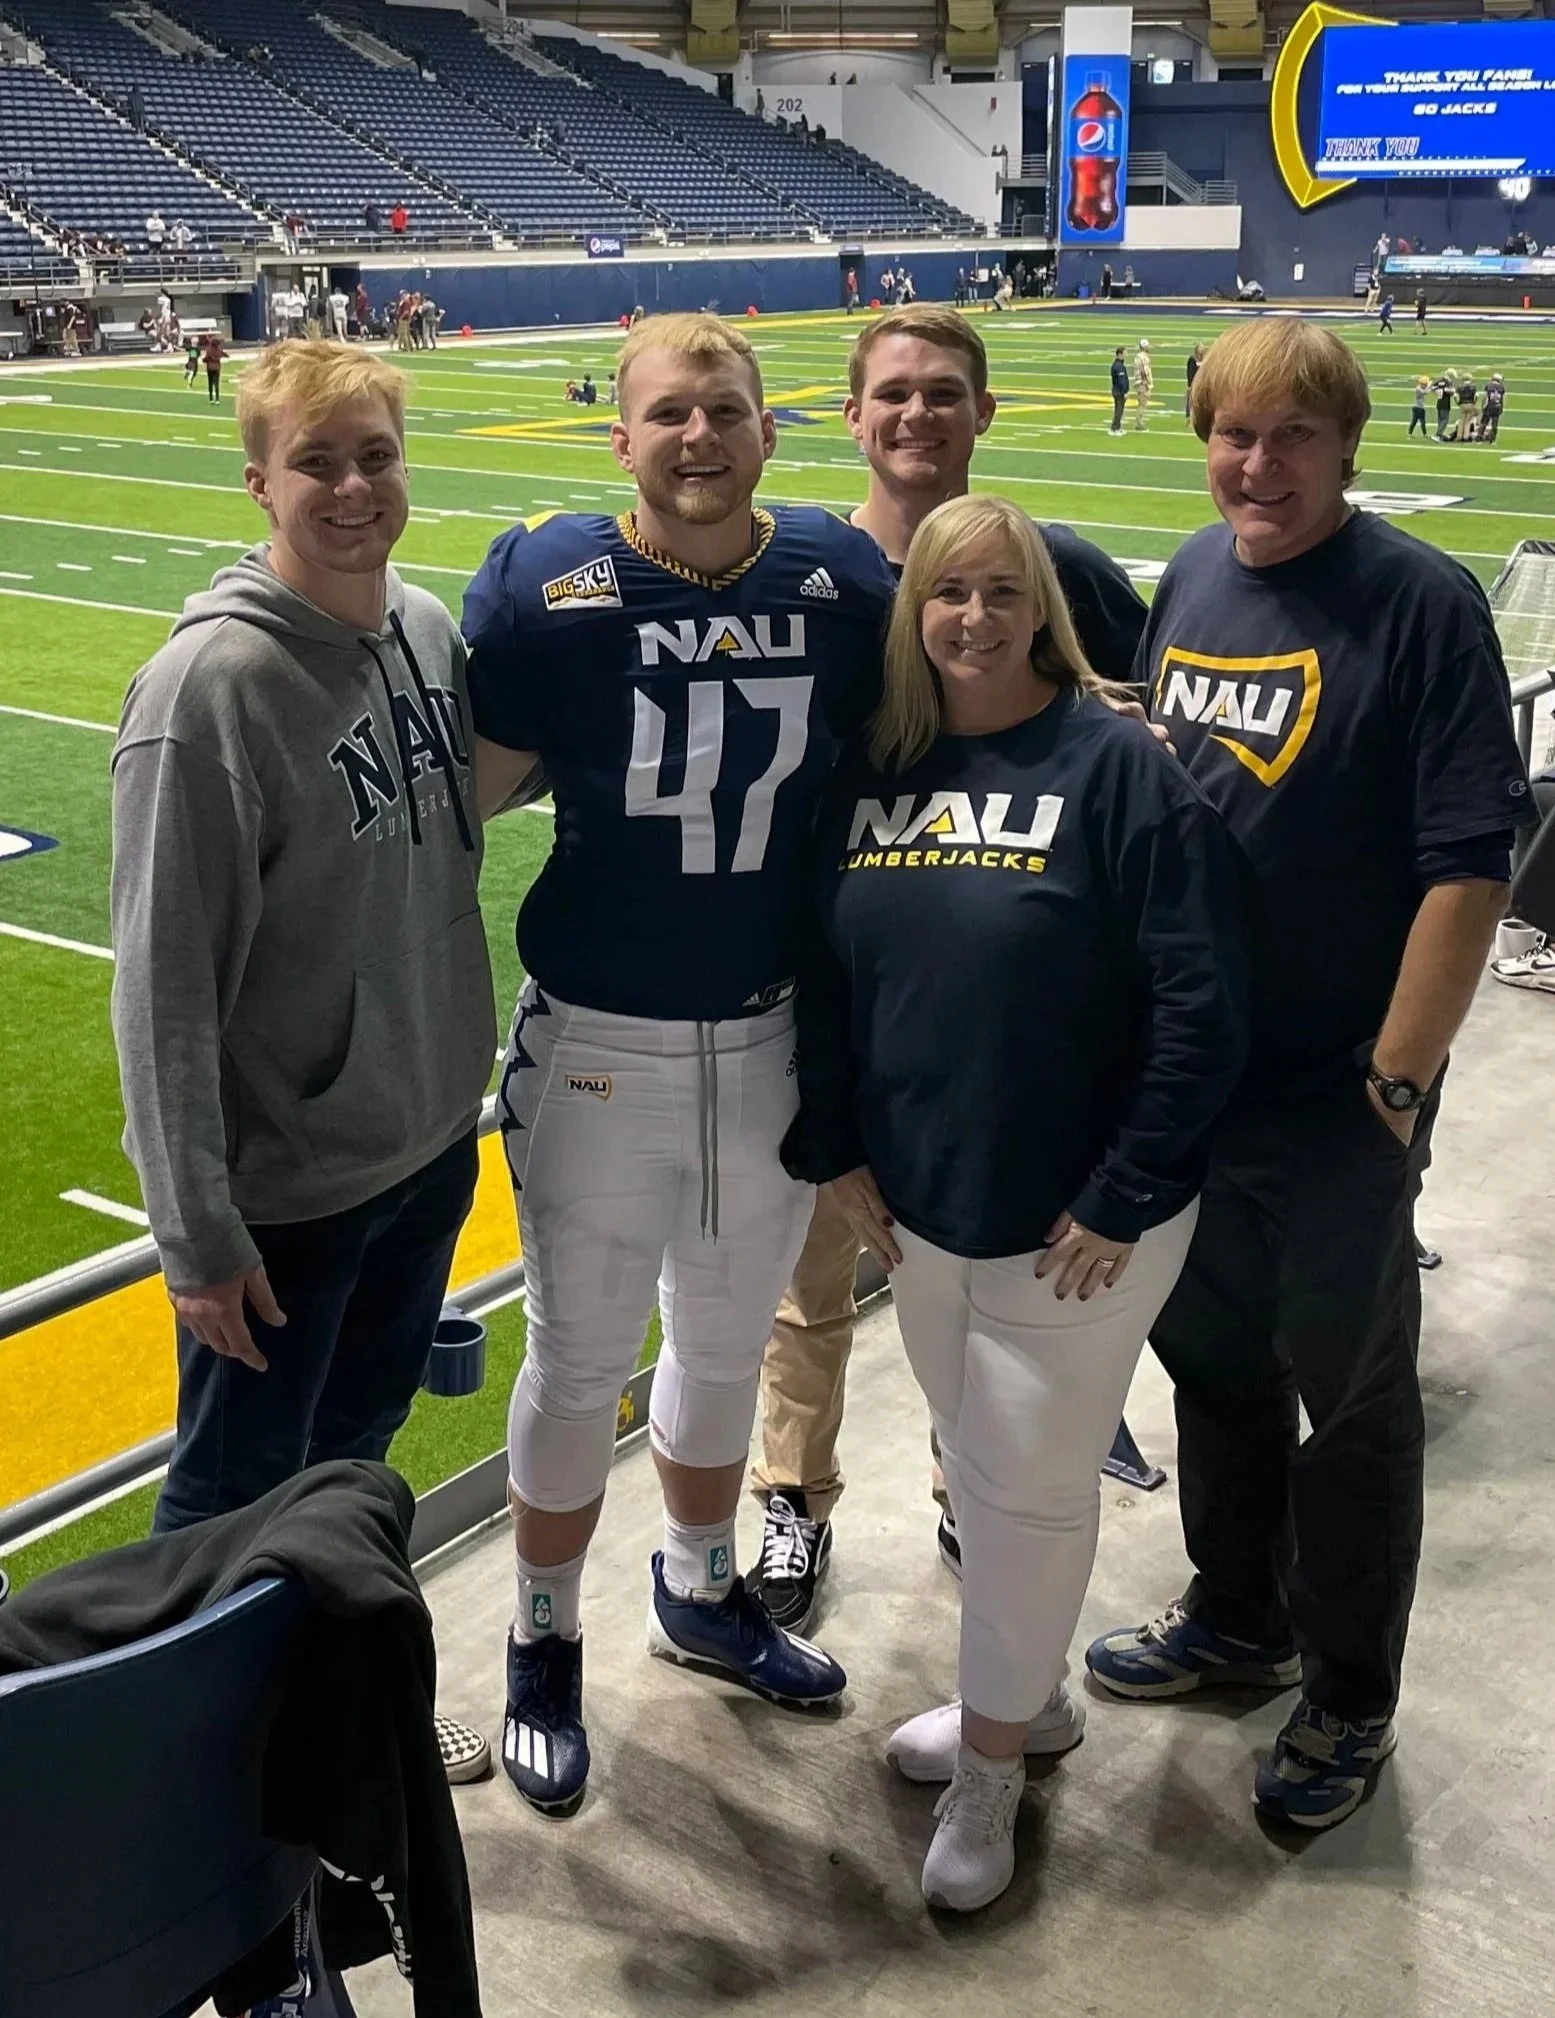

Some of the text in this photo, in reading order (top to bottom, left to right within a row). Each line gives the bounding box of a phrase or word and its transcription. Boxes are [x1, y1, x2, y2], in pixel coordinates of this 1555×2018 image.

[1384, 71, 1440, 83] THANK
[1444, 70, 1480, 82] YOU
[1460, 81, 1486, 91] ALL
[777, 98, 803, 112] 202
[1413, 102, 1497, 115] GO JACKS
[1325, 136, 1420, 157] THANK YOU
[800, 585, 839, 600] adidas
[634, 614, 806, 665] NAU
[1162, 670, 1294, 736] NAU
[326, 684, 471, 841] NAU
[625, 675, 815, 874] 47
[847, 791, 1065, 851] NAU
[570, 1079, 607, 1092] NAU
